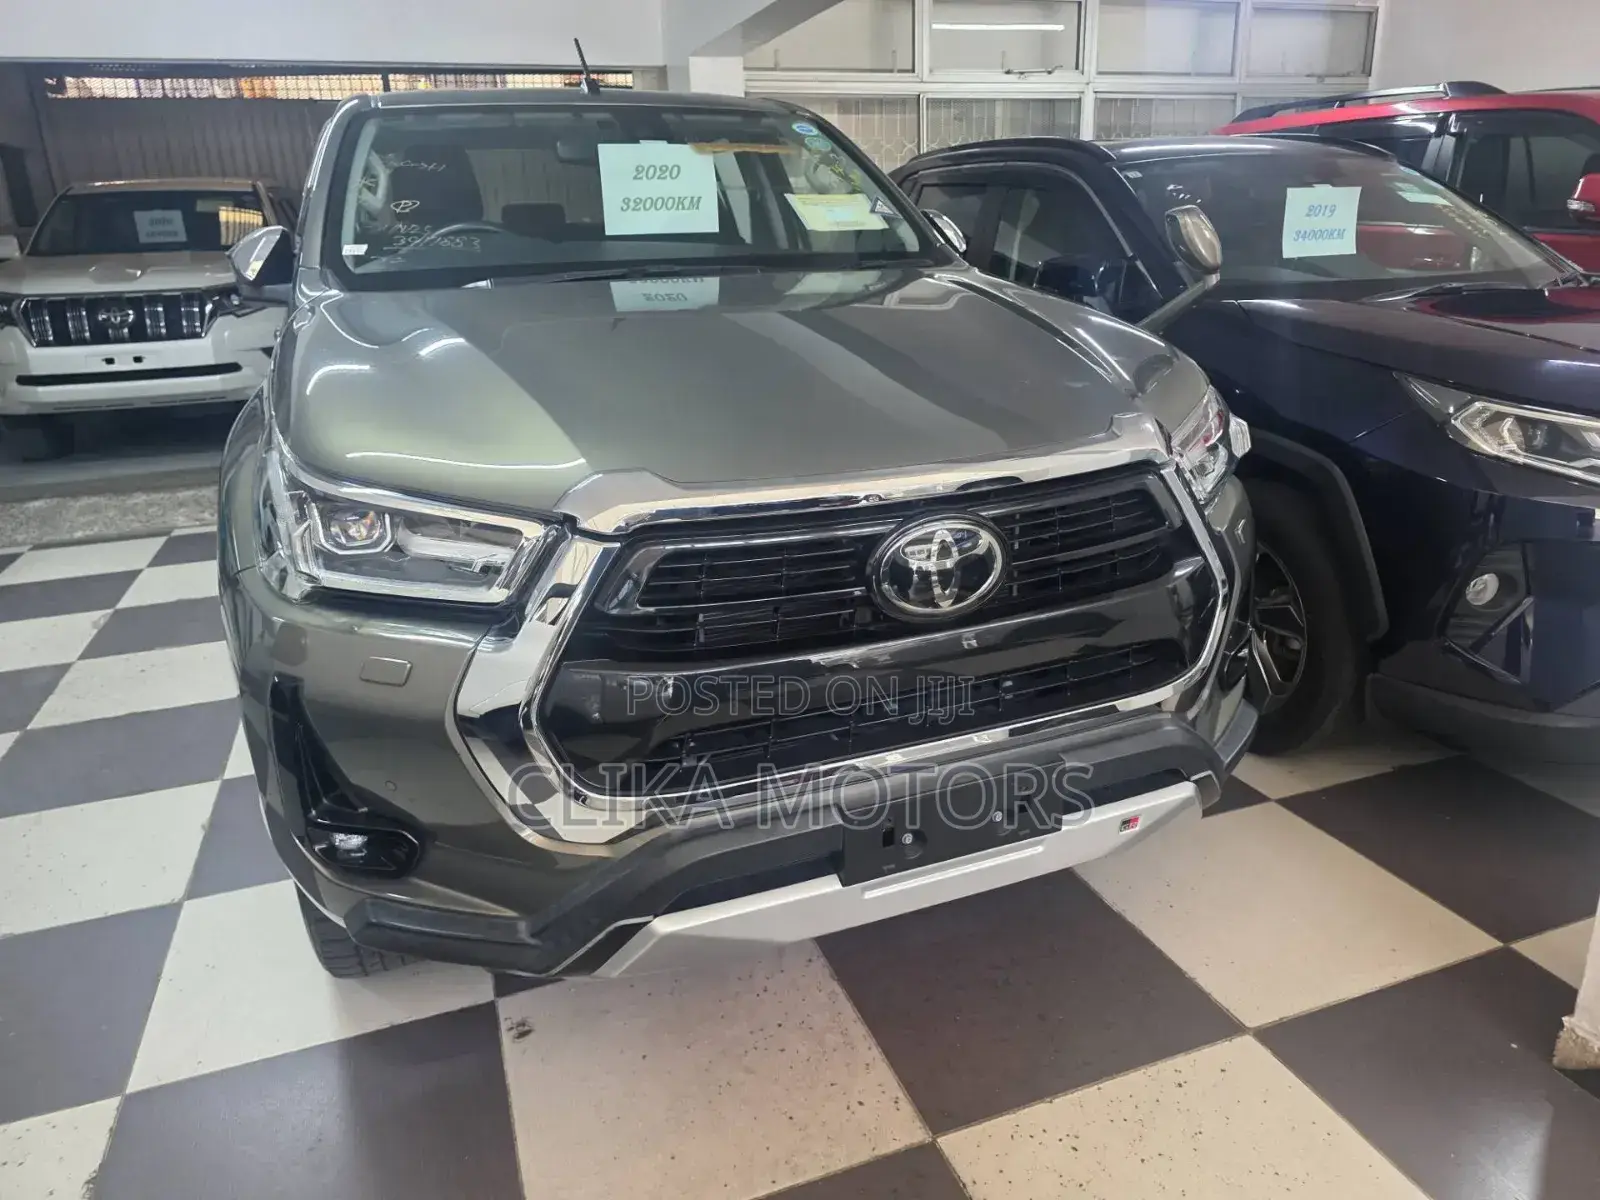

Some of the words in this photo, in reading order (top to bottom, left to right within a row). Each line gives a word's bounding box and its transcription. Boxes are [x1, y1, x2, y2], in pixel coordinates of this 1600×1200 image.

[633, 164, 681, 180] 2020
[620, 196, 702, 212] 32000KM
[1305, 204, 1336, 218] 2019
[1293, 228, 1346, 242] 34000KM
